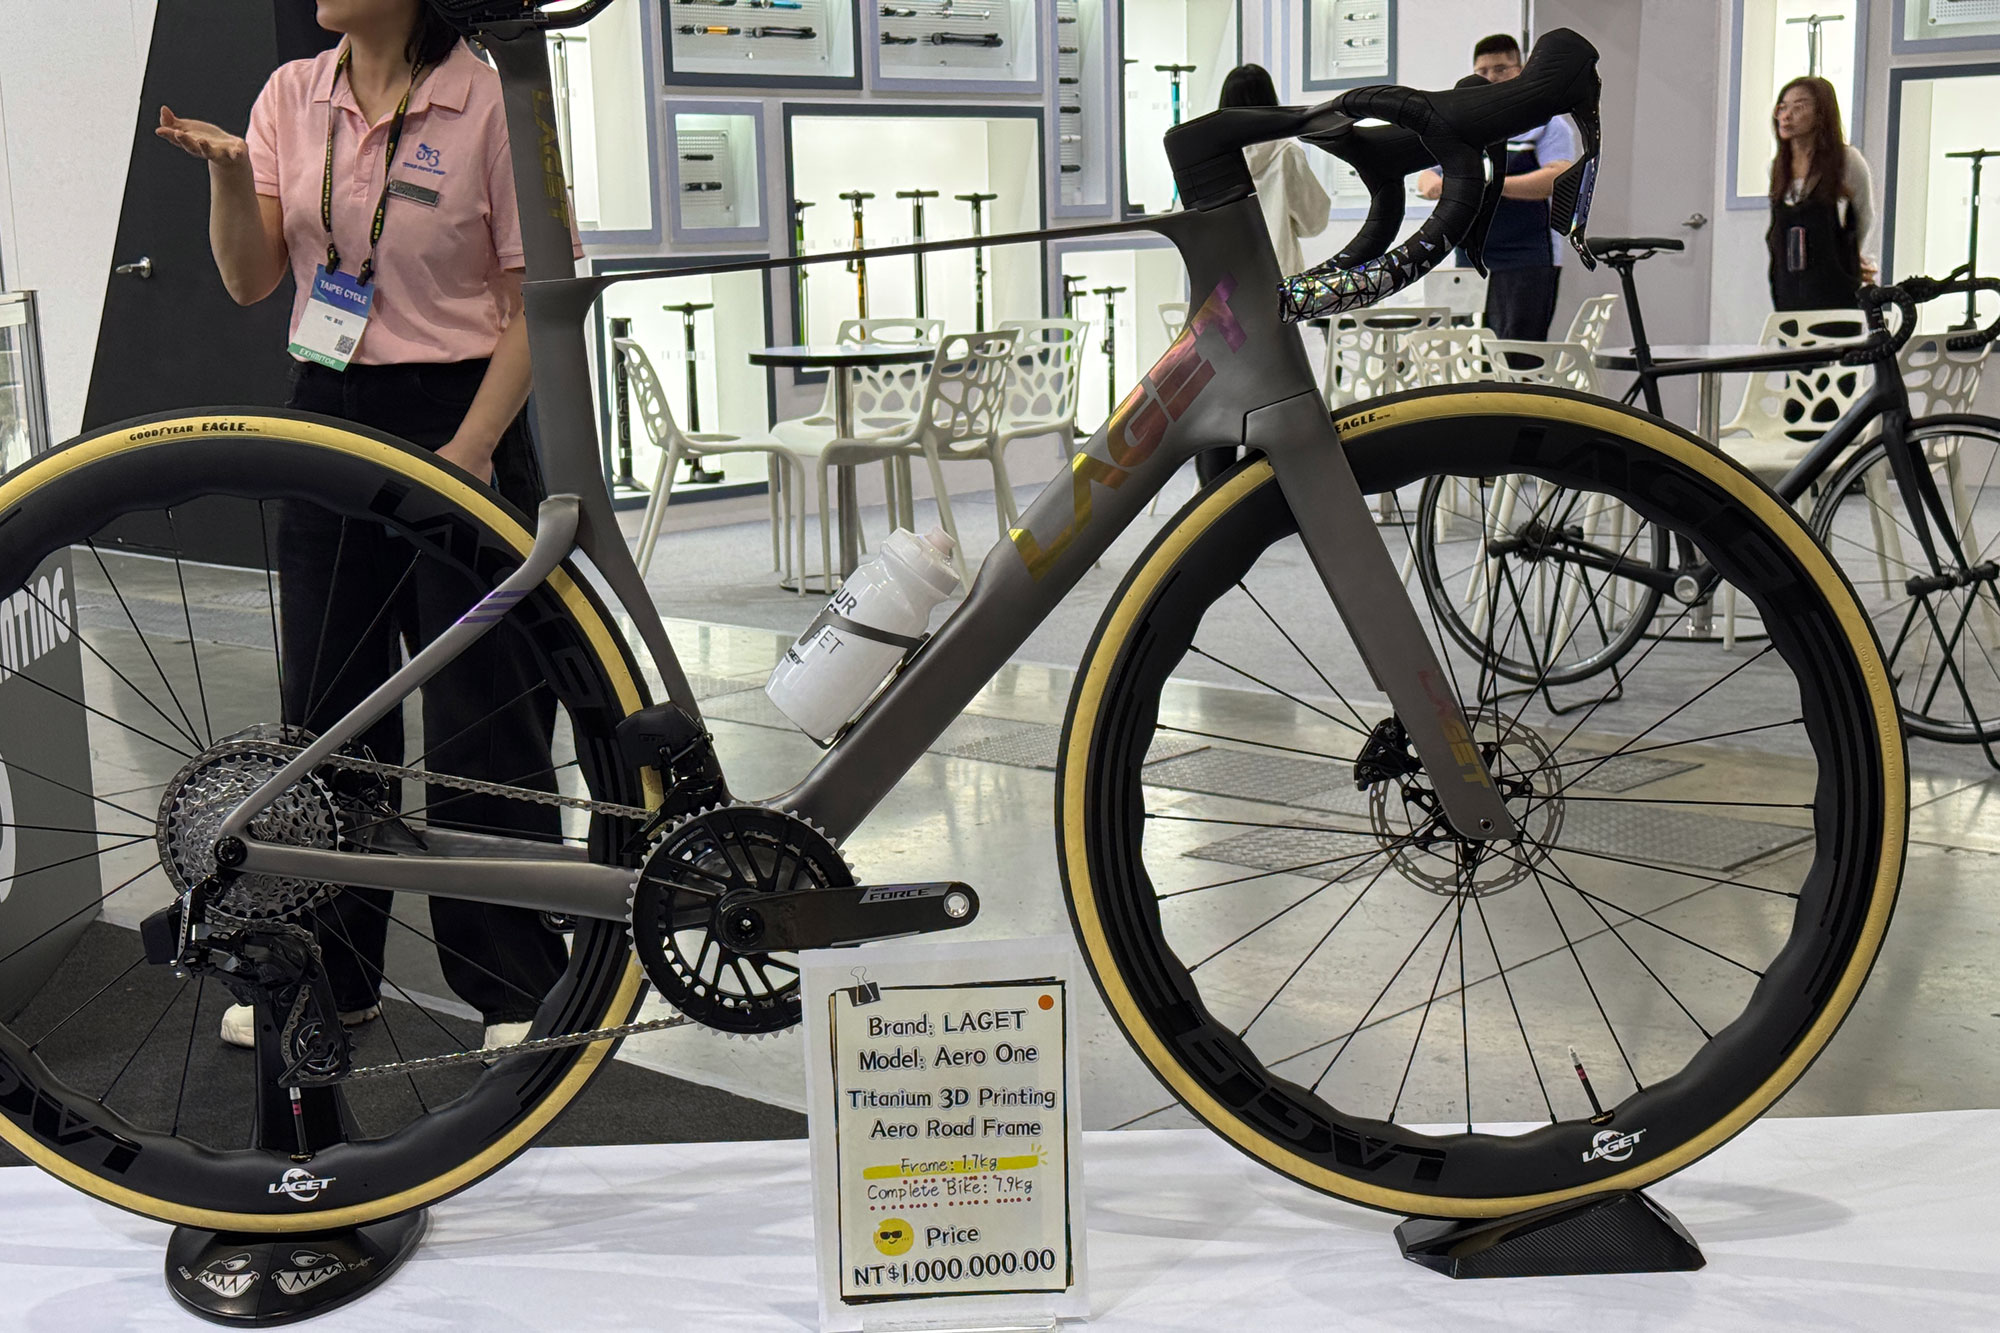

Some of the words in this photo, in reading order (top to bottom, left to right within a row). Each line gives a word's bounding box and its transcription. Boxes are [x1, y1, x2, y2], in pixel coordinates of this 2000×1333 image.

[320, 279, 343, 296] TAIPEI
[343, 288, 368, 305] CYCLE
[299, 347, 336, 366] EXHIBITOR
[129, 424, 194, 442] GOODYEAR
[201, 421, 247, 432] EAGLE
[1008, 271, 1247, 584] LAGET
[1335, 412, 1376, 434] EAGLE
[1418, 668, 1491, 788] LAGET
[870, 887, 931, 901] FORCE
[868, 1013, 935, 1038] Brand:
[943, 1008, 1029, 1034] LAGET
[858, 1047, 926, 1071] Model:
[934, 1046, 987, 1068] Aero
[995, 1043, 1038, 1065] One
[846, 1088, 933, 1109] Titanium
[939, 1088, 970, 1110] 3D
[978, 1087, 1057, 1110] Printing
[870, 1118, 918, 1139] Aero
[926, 1116, 975, 1137] Road
[983, 1116, 1043, 1137] Frame
[1582, 1129, 1645, 1163] LAGET
[900, 1157, 955, 1174] Frame:
[962, 1153, 999, 1171] 1.7kg
[268, 1178, 334, 1194] LAGET
[867, 1180, 940, 1201] Complete
[946, 1177, 989, 1196] Bike:
[995, 1176, 1034, 1194] 7.9kg
[926, 1227, 980, 1247] Price
